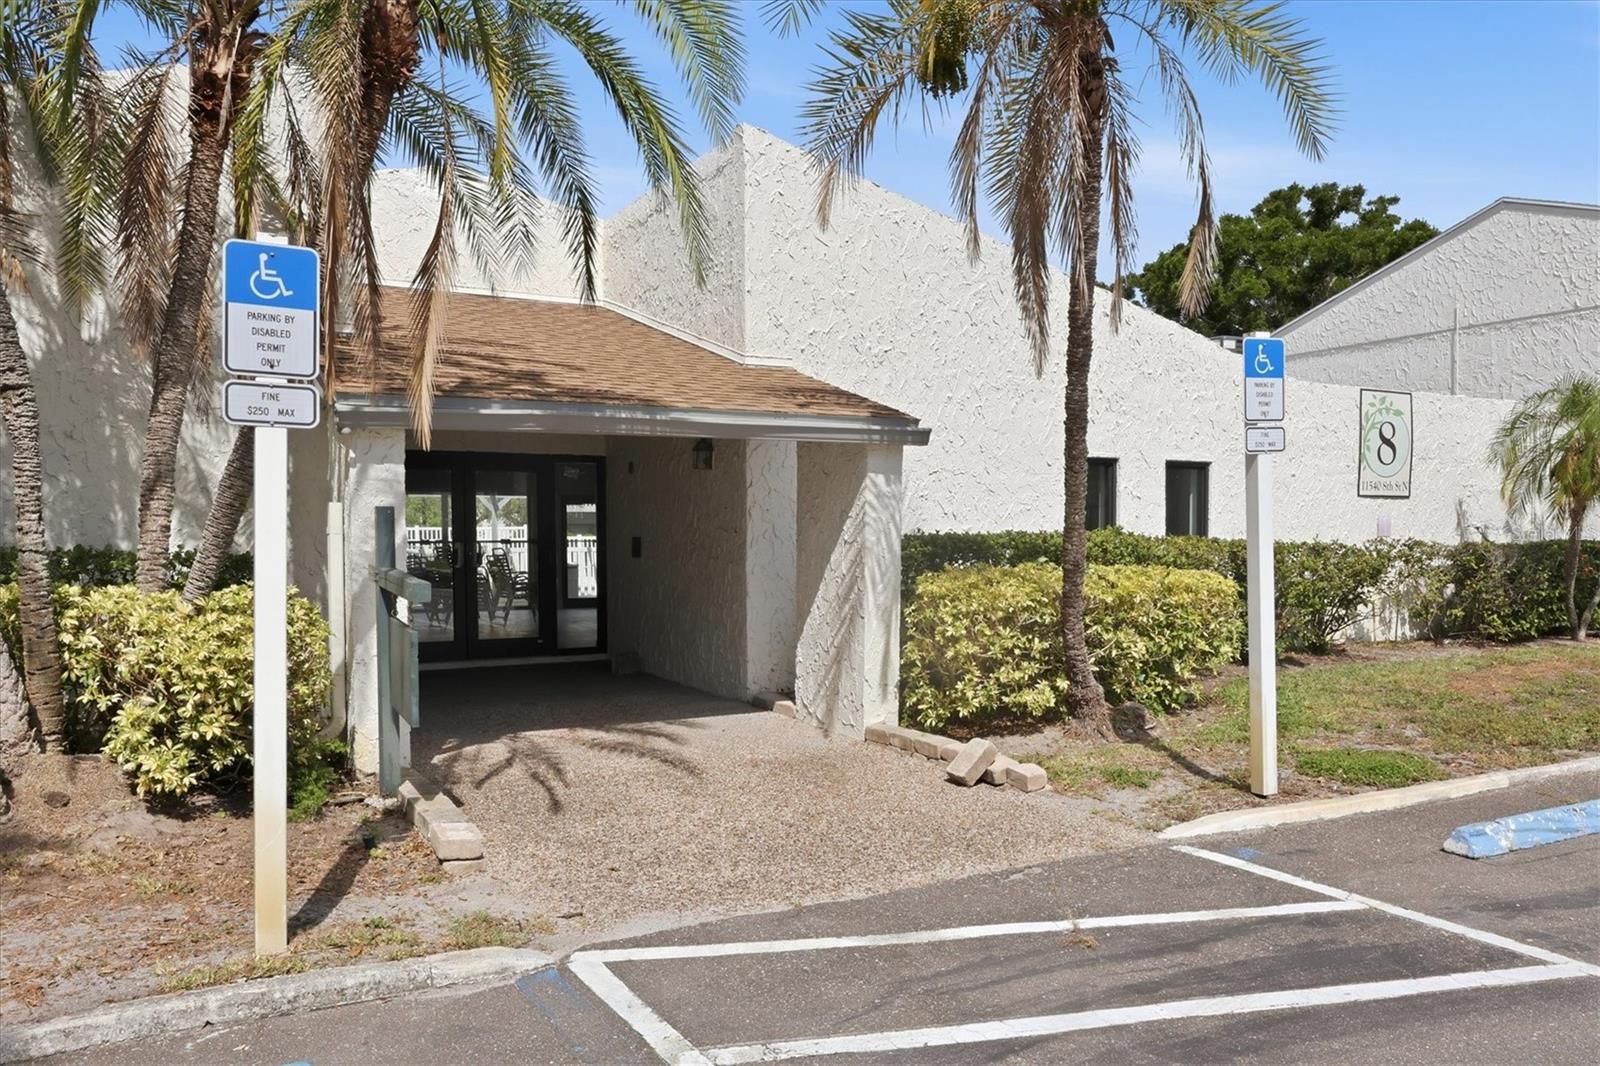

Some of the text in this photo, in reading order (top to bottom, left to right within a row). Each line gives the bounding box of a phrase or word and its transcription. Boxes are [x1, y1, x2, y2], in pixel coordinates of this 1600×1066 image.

[247, 311, 295, 324] PARKING BY
[251, 327, 291, 339] DISABLED
[256, 342, 286, 353] PERMIT
[260, 357, 281, 367] ONLY
[261, 391, 280, 402] FINE
[247, 405, 295, 417] $250 MAX
[1377, 421, 1397, 466] 8
